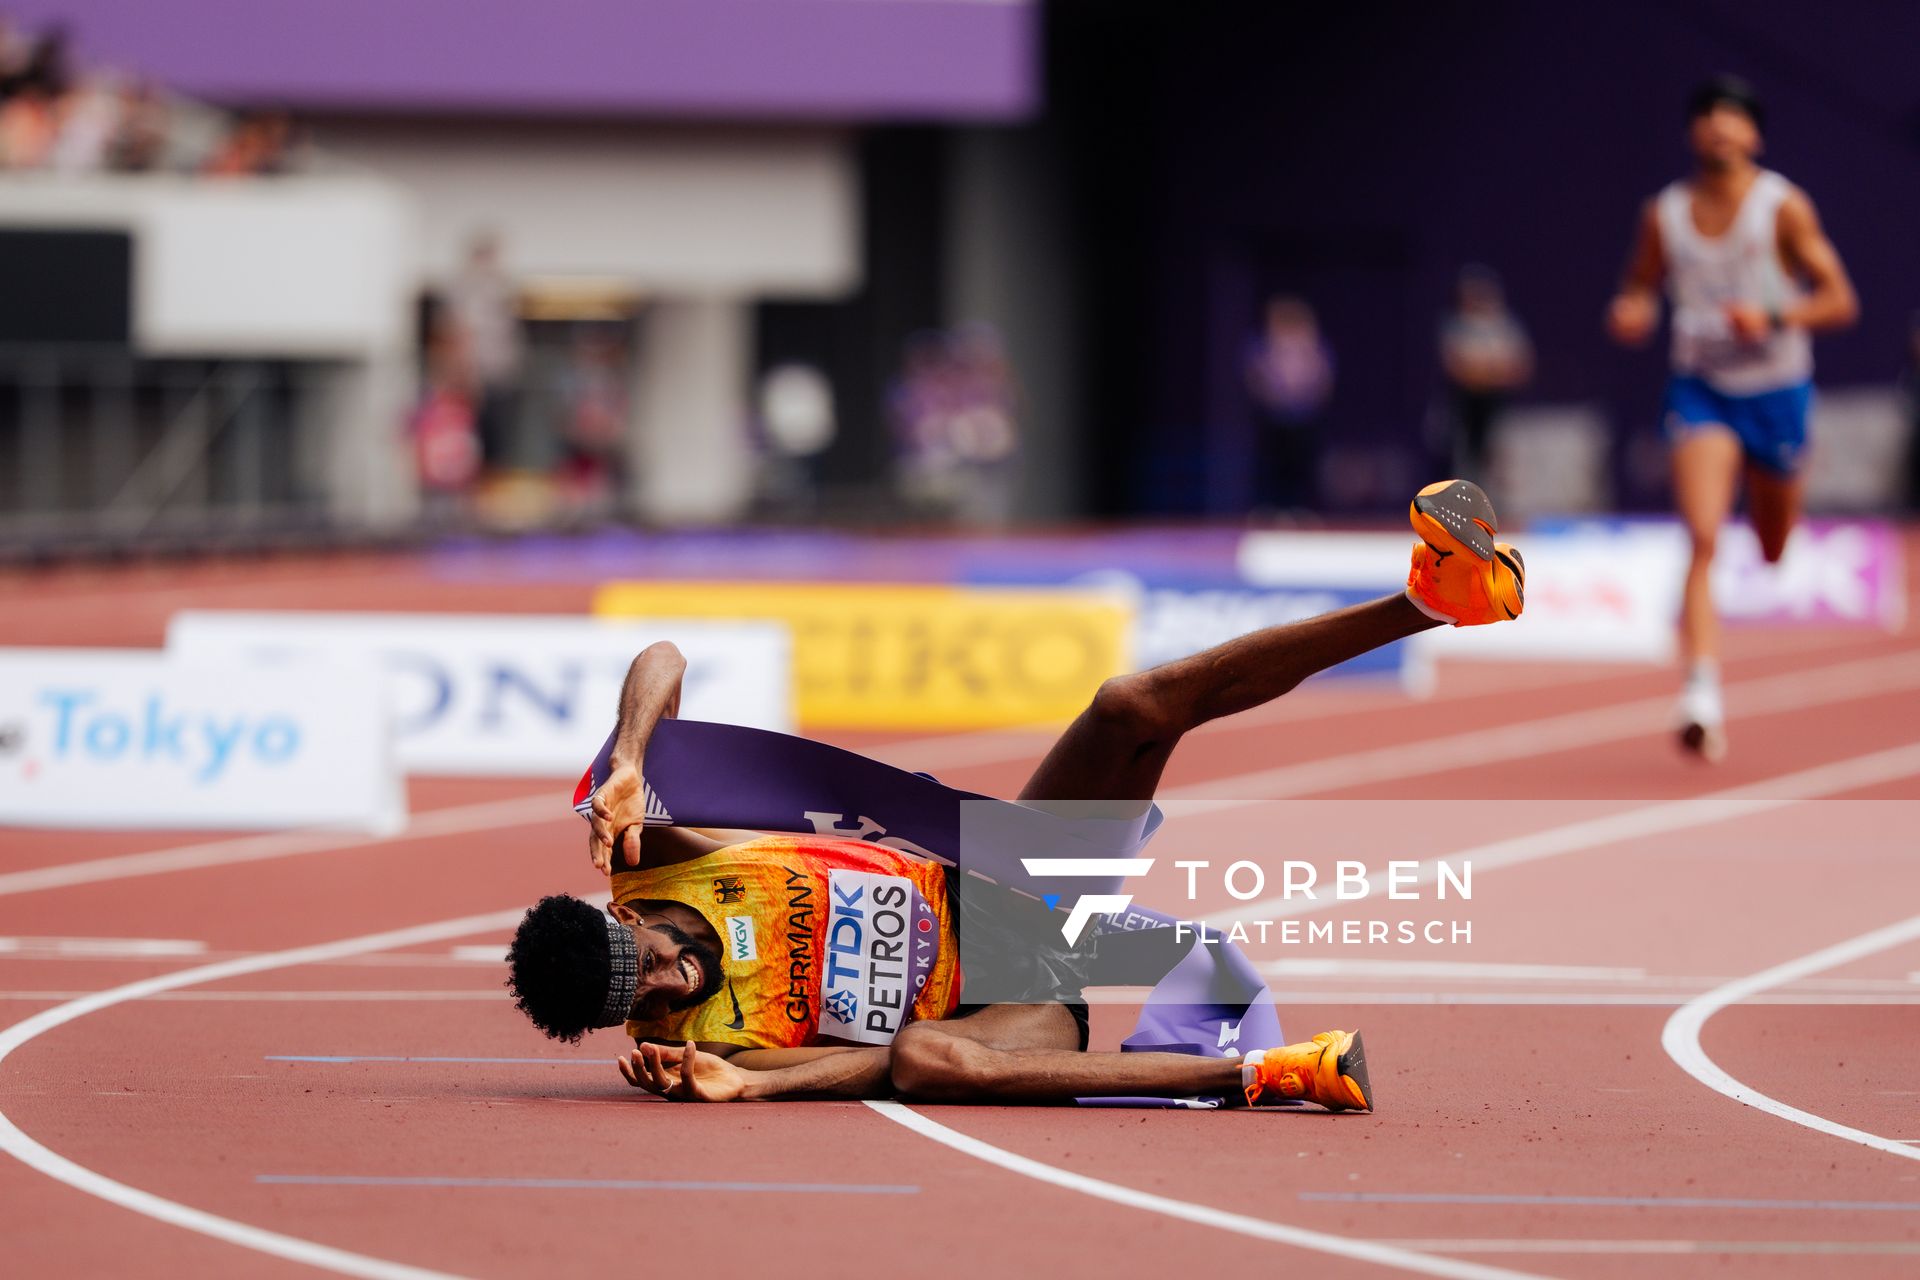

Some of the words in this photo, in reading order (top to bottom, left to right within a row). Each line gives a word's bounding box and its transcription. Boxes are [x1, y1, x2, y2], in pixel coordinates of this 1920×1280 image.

[37, 687, 300, 786] Tokyo
[732, 918, 749, 959] WGV
[783, 866, 815, 1023] GERMANY
[826, 882, 864, 988] TDK
[865, 885, 907, 1034] PETROS
